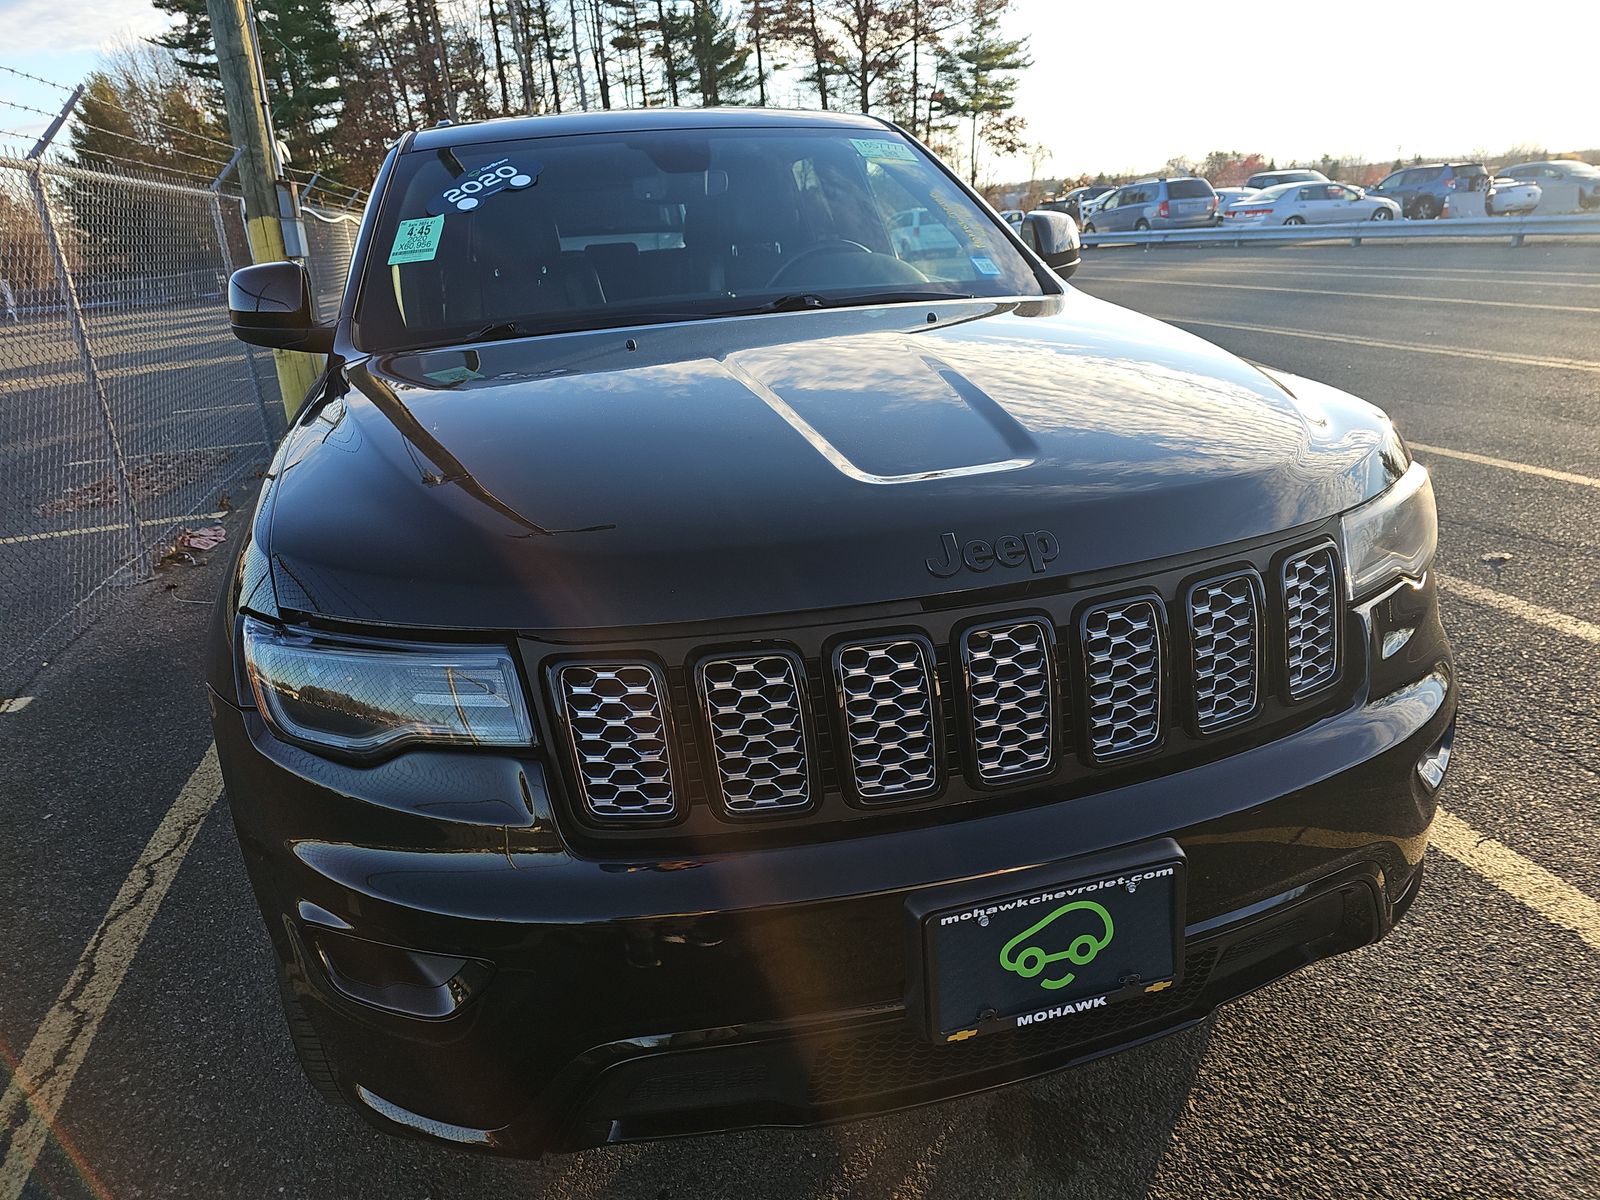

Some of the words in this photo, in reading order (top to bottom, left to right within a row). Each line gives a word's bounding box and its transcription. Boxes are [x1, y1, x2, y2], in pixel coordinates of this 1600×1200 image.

[442, 166, 518, 203] 2020
[398, 241, 432, 251] X60,956
[407, 225, 431, 237] 4:45
[925, 529, 1060, 578] Jeep
[940, 867, 1174, 927] mohawkchevrolet.com
[1016, 996, 1107, 1027] MOHAWK
